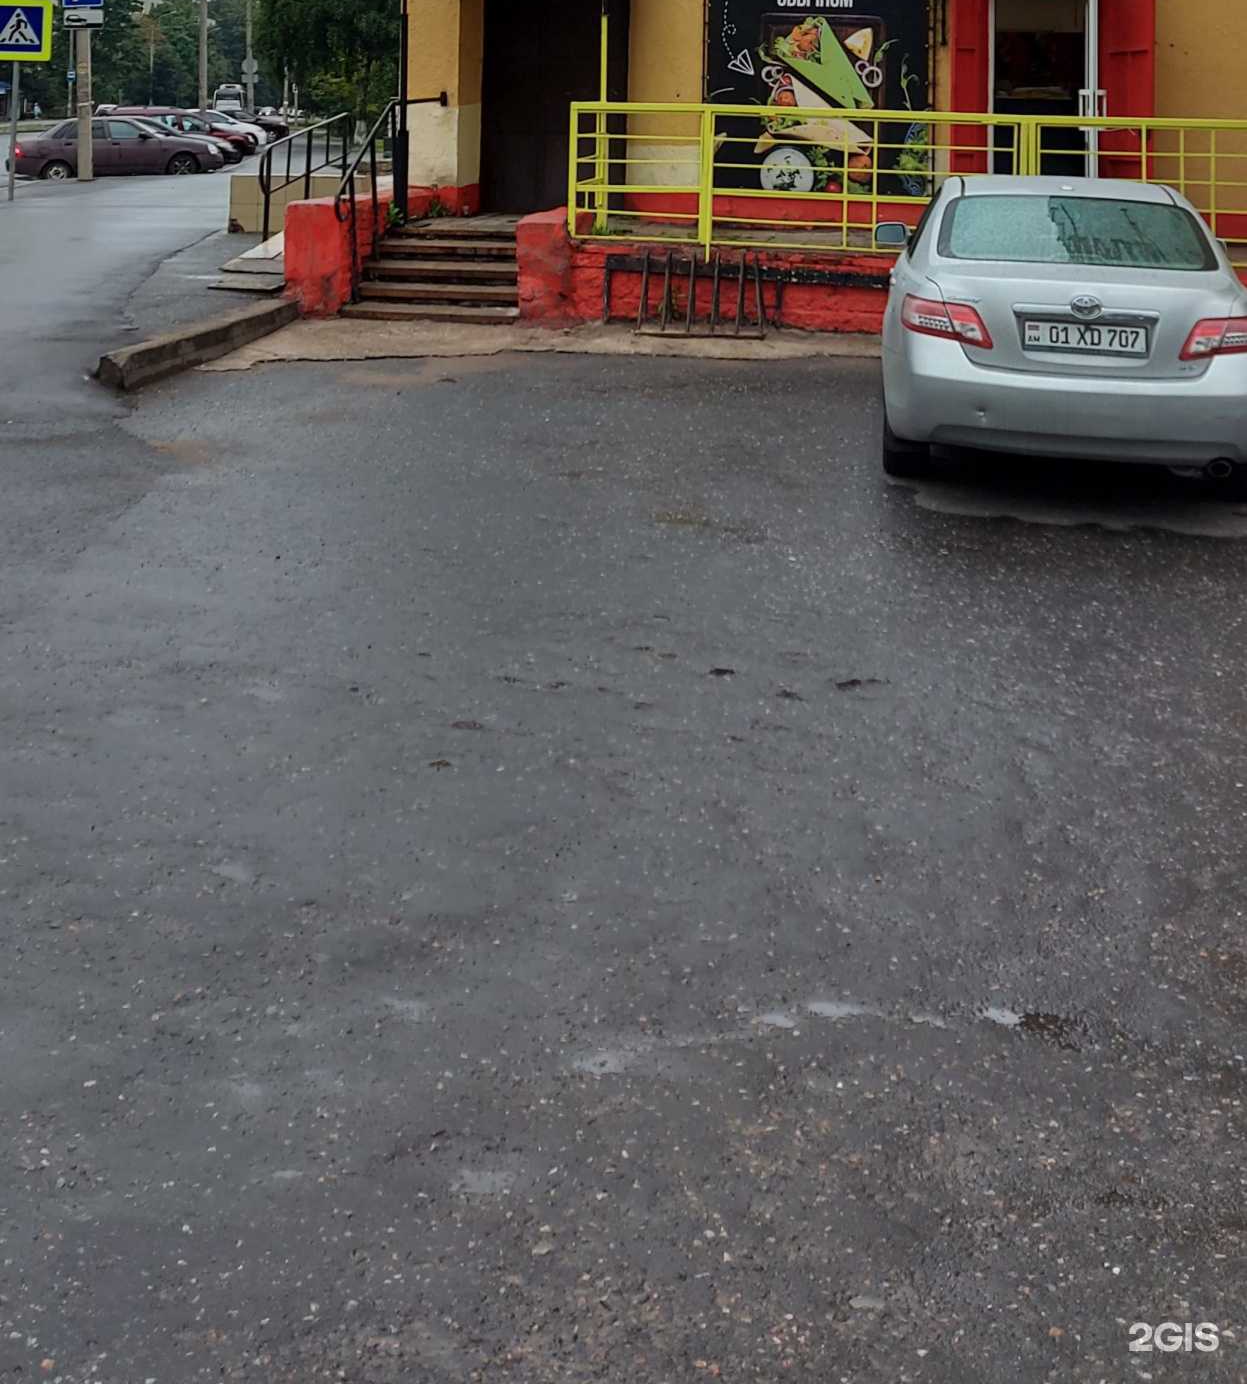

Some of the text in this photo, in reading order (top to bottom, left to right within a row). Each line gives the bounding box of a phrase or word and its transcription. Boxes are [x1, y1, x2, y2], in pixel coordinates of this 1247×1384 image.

[1027, 335, 1040, 343] AM
[1049, 326, 1070, 344] 01
[1107, 329, 1140, 348] 707
